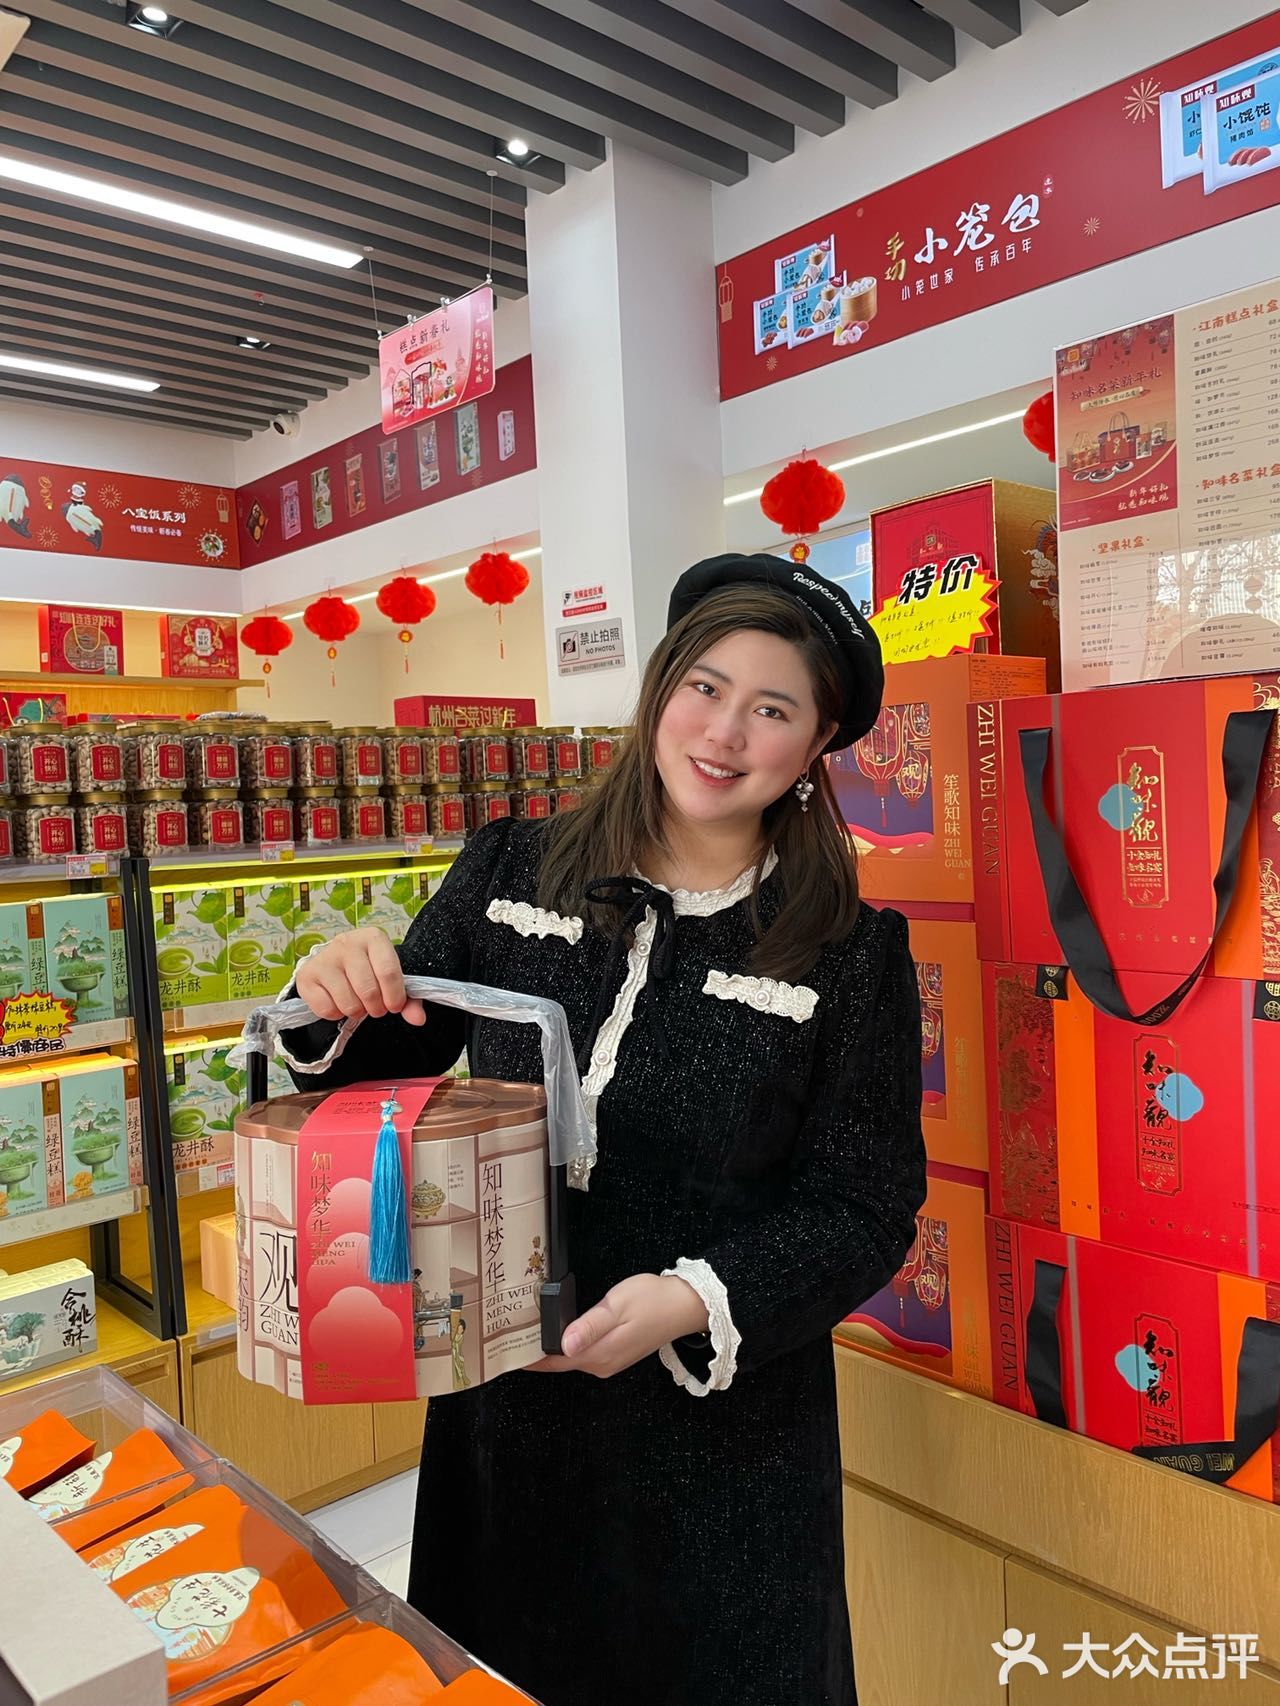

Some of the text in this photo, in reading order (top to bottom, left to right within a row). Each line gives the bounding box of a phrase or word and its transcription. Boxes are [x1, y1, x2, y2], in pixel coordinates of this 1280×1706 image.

[1223, 102, 1271, 130] 小馄饨
[914, 194, 1040, 264] 小笼包
[975, 238, 1032, 272] 传承百年
[902, 268, 954, 300] 小笼世家
[122, 507, 187, 524] 八宝饭系列
[793, 572, 839, 601] Respect
[899, 554, 978, 604] 特价
[580, 627, 620, 646] 禁止拍照
[594, 645, 616, 653] PHOTOS
[428, 704, 516, 728] 杭州名菜过新年
[977, 704, 1000, 877] ZHI WEI GUAN
[944, 838, 961, 848] ZHI
[160, 977, 202, 996] 龙井酥
[232, 967, 271, 987] 龙井酥
[128, 1116, 142, 1158] 绿豆糕
[172, 1136, 215, 1158] 龙井酥
[45, 1133, 61, 1177] 绿豆糕
[310, 1151, 332, 1242] 知味梦华
[483, 1163, 506, 1294] 知味梦华
[334, 1241, 356, 1249] WEI
[486, 1284, 534, 1308] ZHI WEI
[994, 1222, 1019, 1392] ZHI WEI GUAN
[260, 1303, 281, 1320] ZHI
[486, 1301, 523, 1322] MENG
[261, 1321, 299, 1346] GUAN
[486, 1317, 512, 1335] HUA
[181, 1578, 227, 1618] 七彩花生
